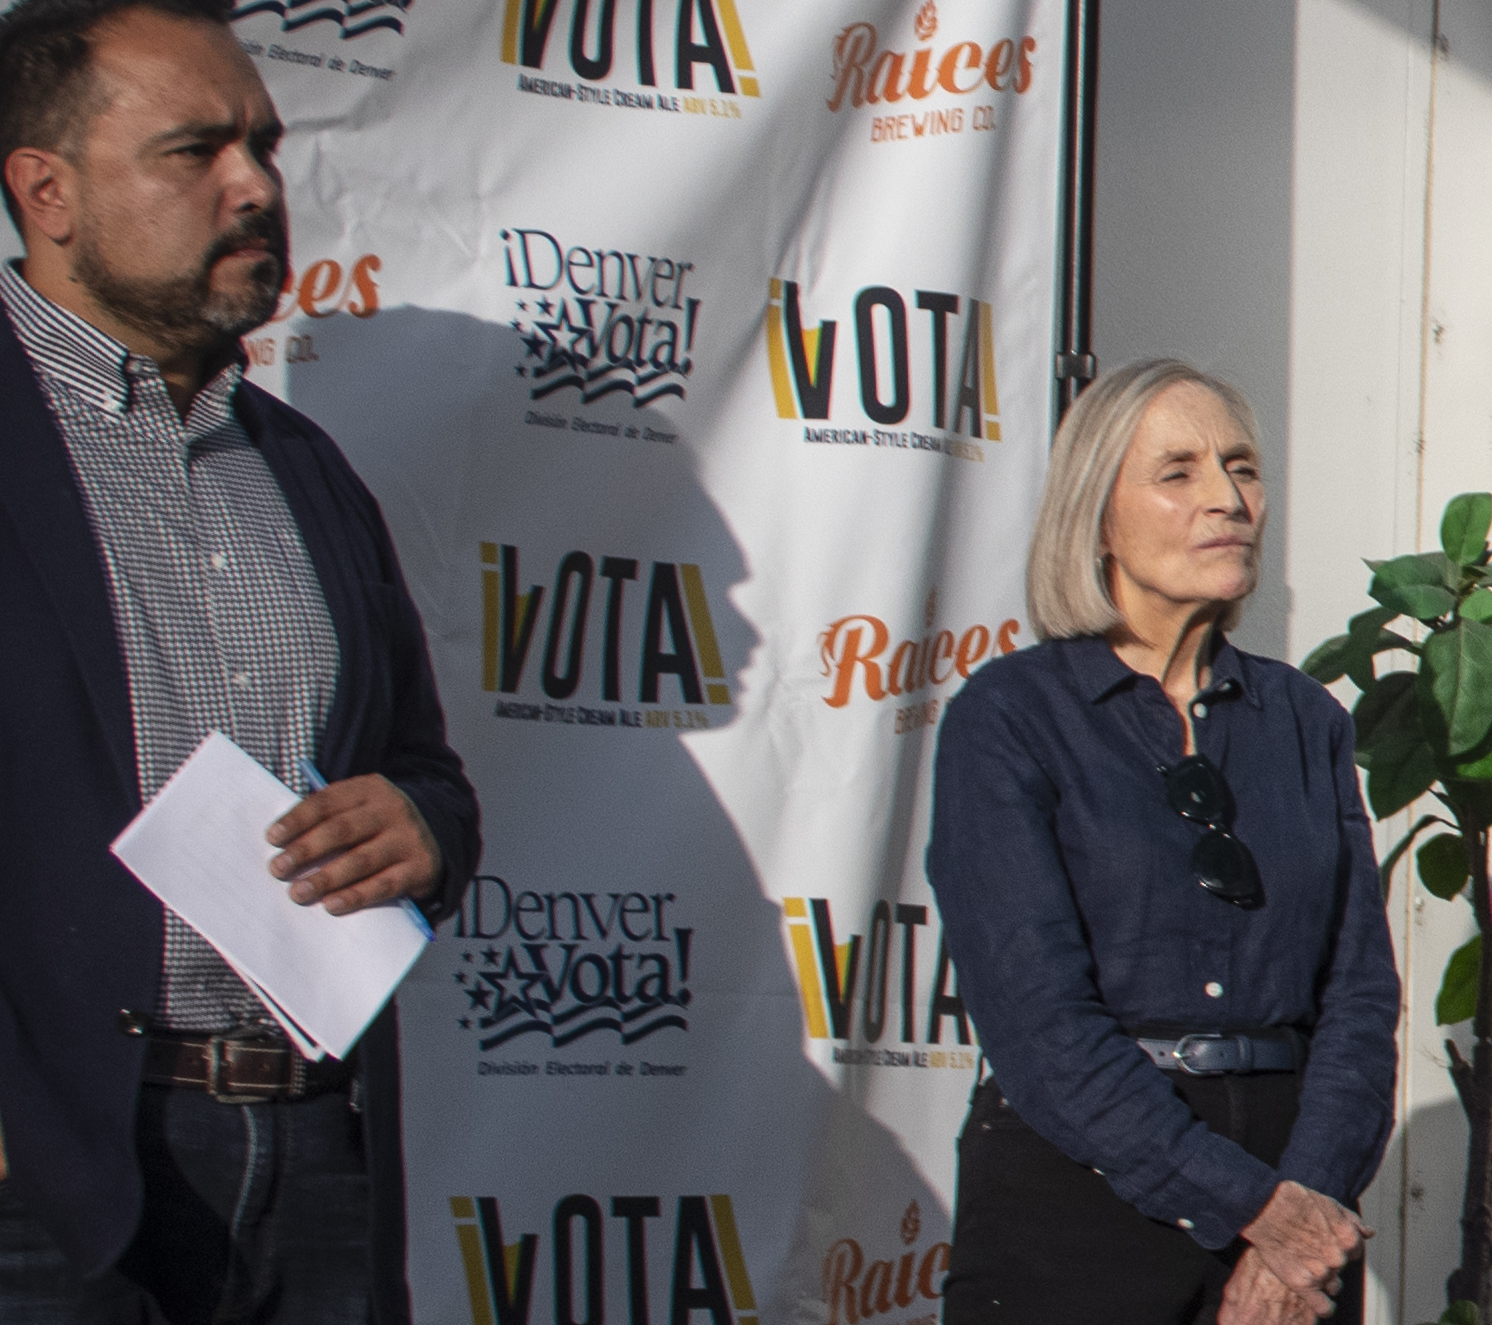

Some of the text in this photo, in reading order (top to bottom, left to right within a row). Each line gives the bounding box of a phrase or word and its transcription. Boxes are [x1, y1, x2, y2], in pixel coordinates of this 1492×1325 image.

[870, 108, 965, 143] BREWING
[573, 295, 703, 381] Vota!
[479, 540, 733, 706] ¡VOTA!
[521, 927, 695, 1010] Vota!
